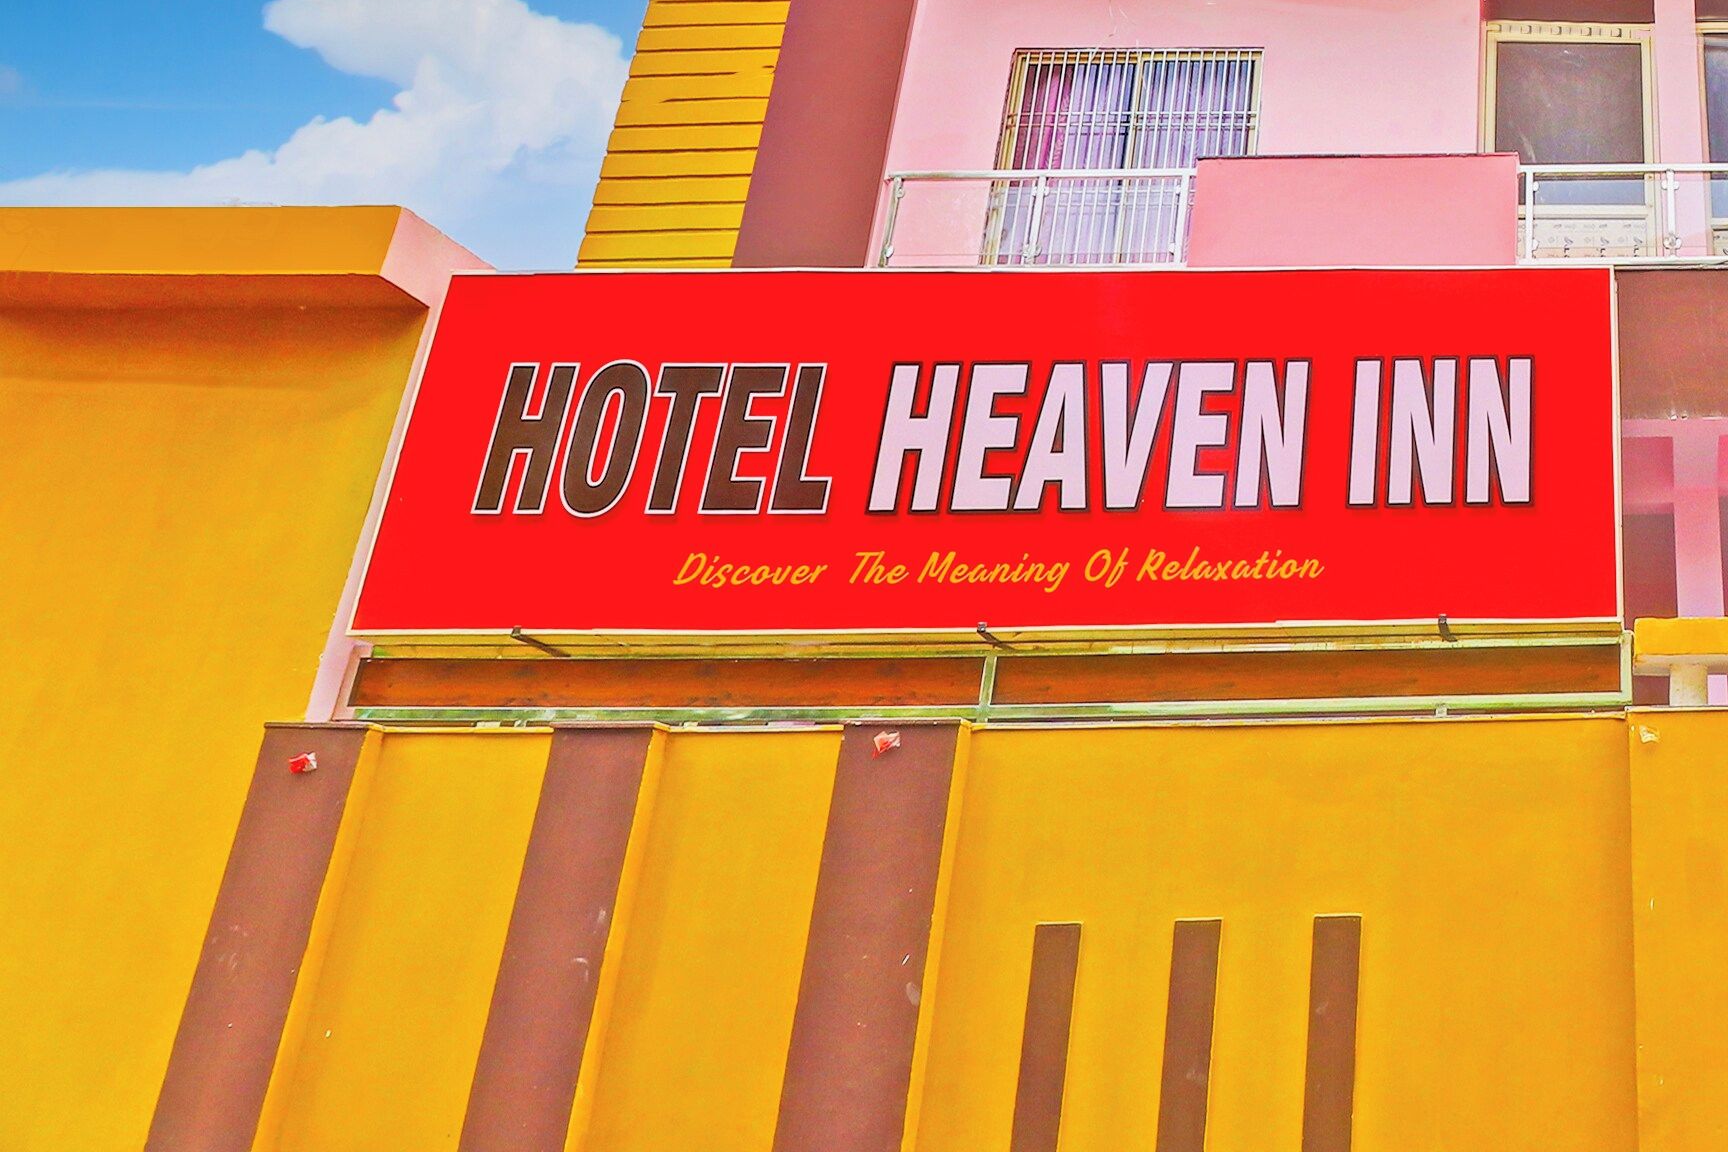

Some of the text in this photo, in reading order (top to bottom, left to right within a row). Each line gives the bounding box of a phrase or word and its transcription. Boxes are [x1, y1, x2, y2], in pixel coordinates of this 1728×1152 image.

[470, 355, 1536, 520] HOTEL HEAVEN INN
[672, 546, 1325, 593] Discover The Meaning Of Relaxation
